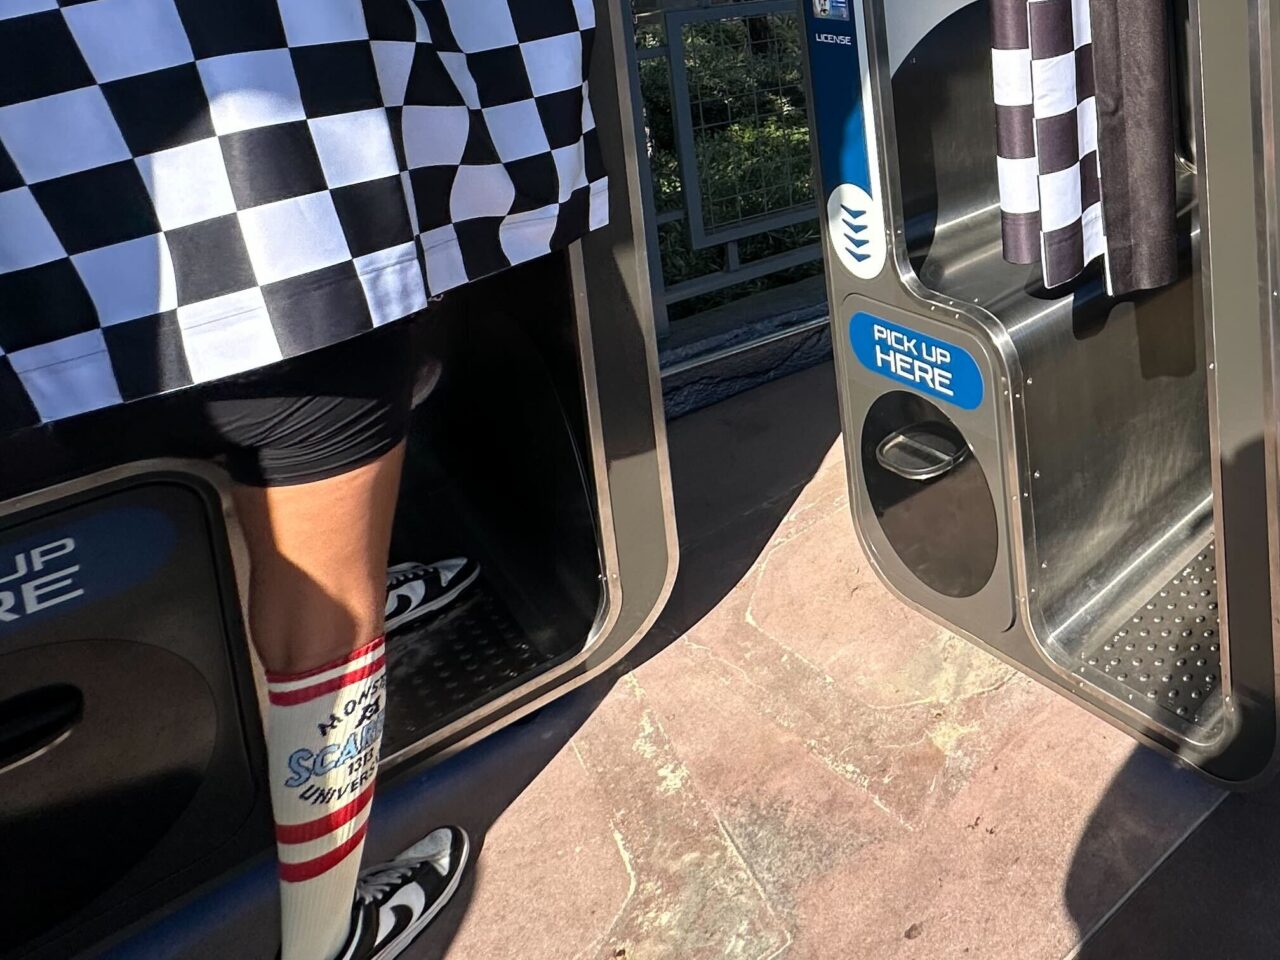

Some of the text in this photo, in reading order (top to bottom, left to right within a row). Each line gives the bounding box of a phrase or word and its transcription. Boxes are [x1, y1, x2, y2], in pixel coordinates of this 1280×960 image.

[815, 32, 852, 45] LICENSE
[873, 324, 951, 365] PICK UP
[875, 344, 954, 397] HERE
